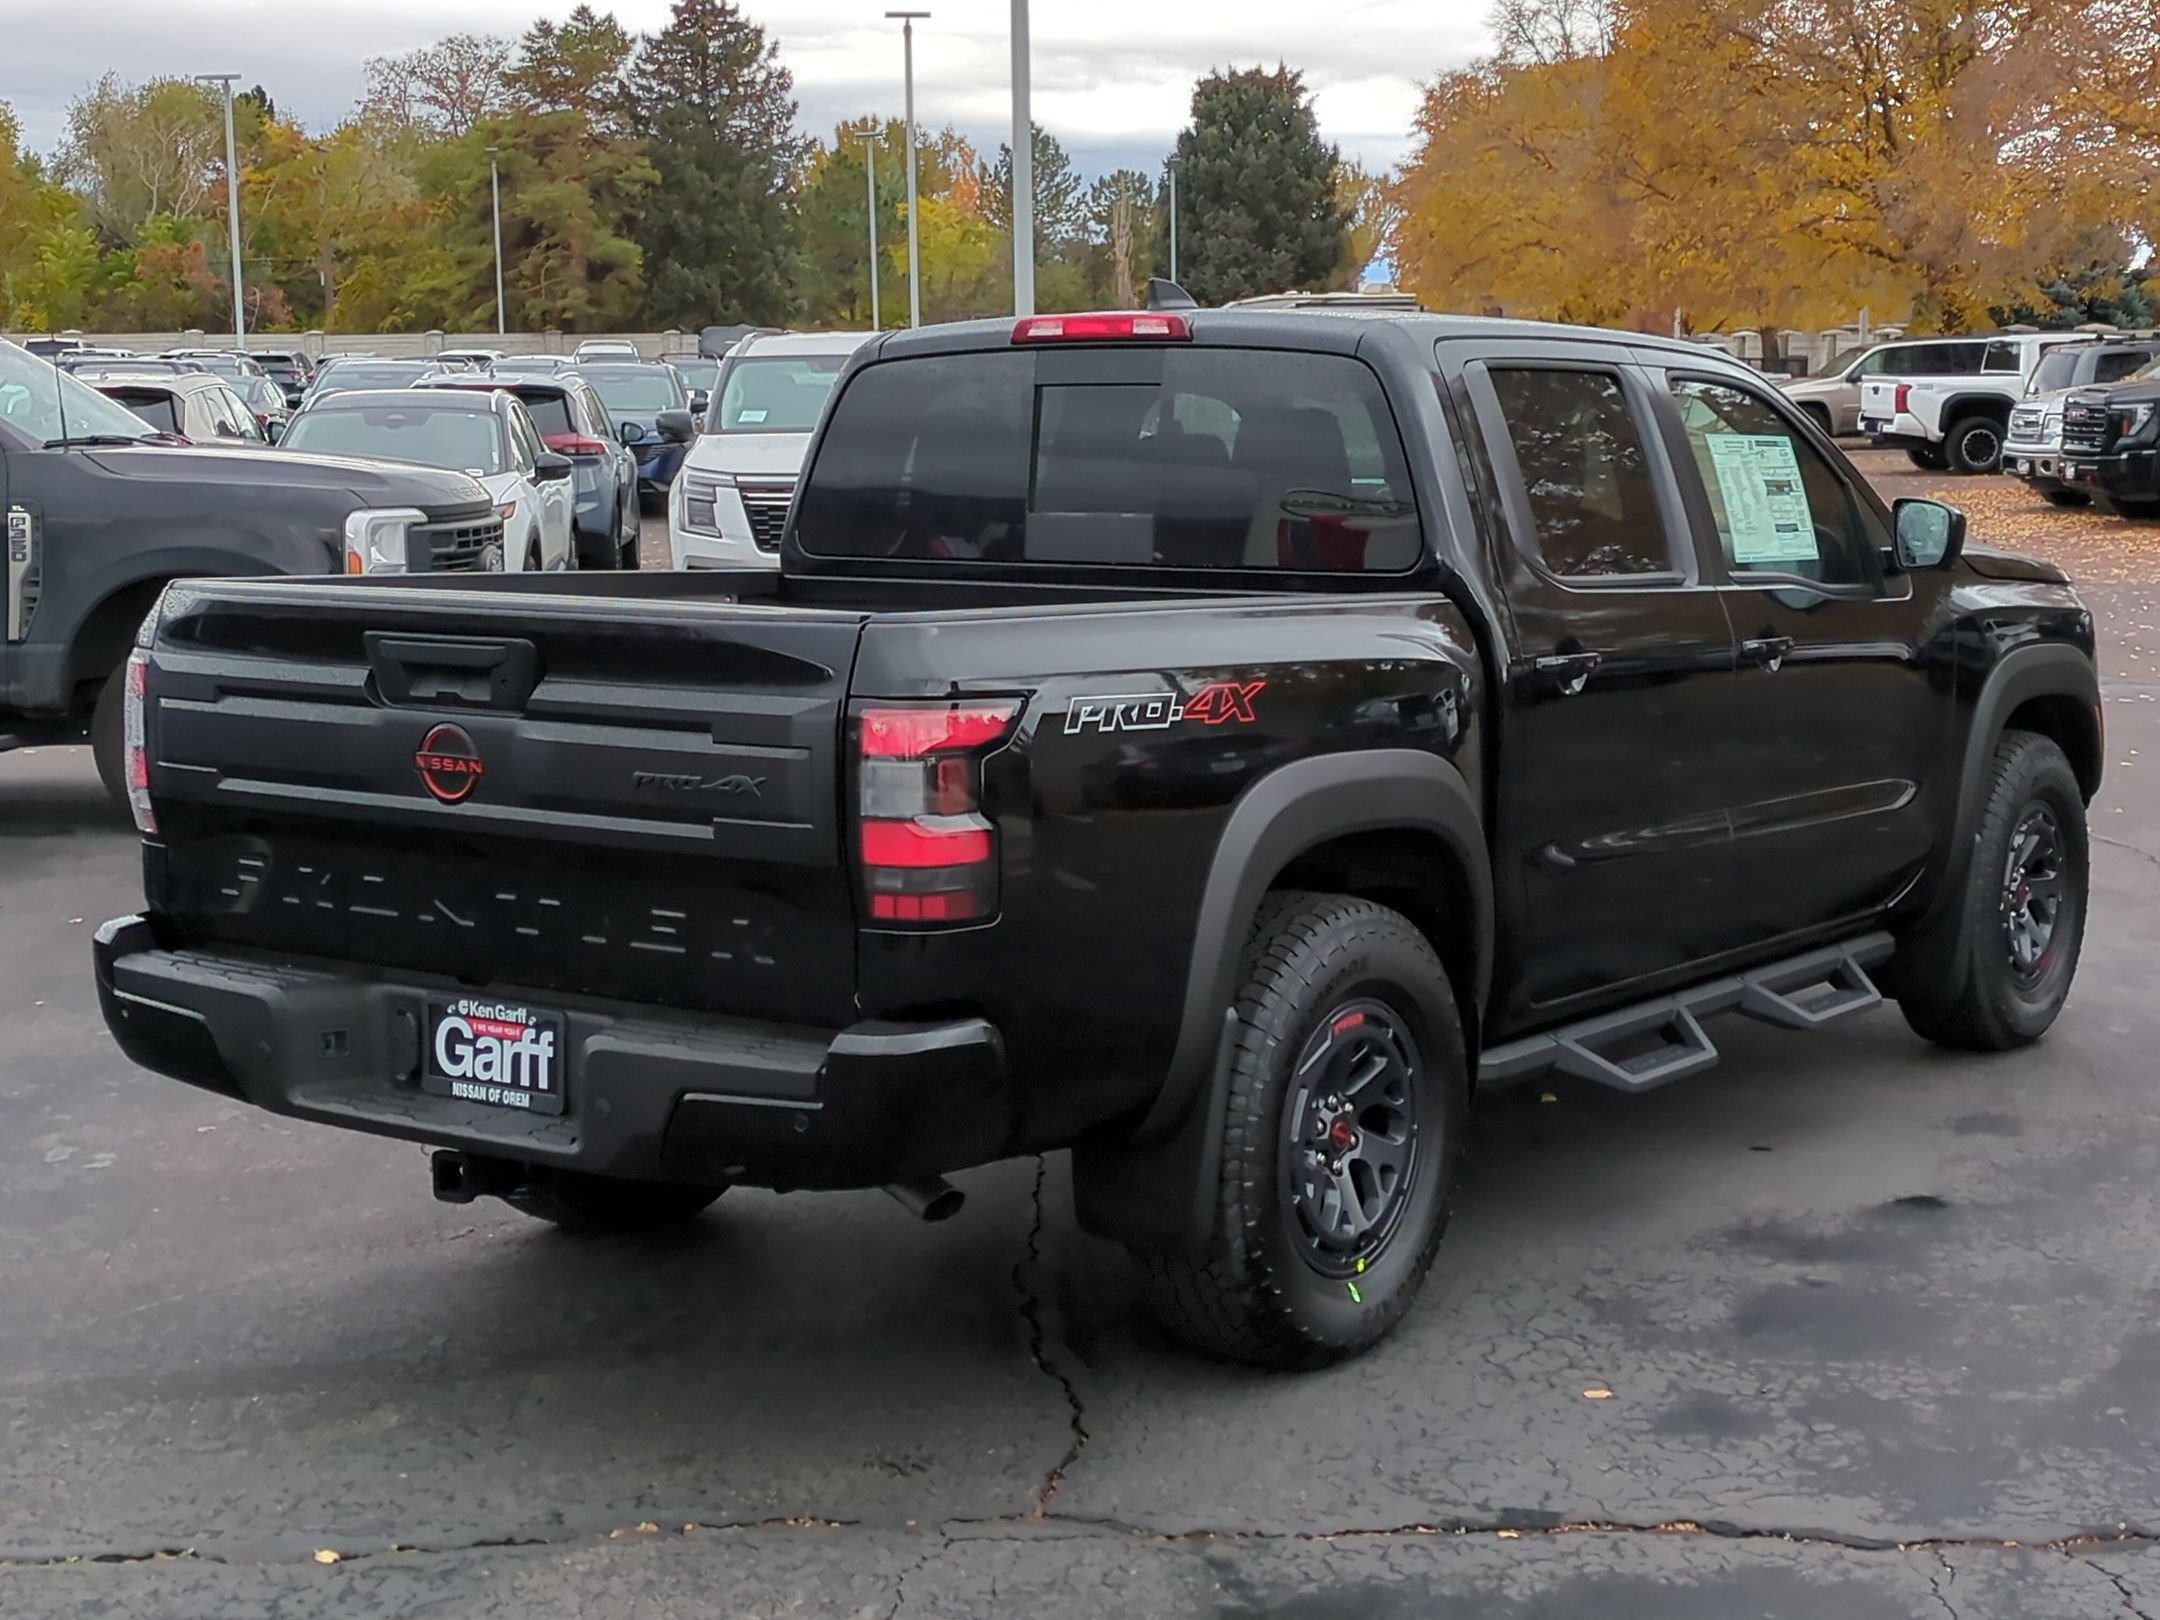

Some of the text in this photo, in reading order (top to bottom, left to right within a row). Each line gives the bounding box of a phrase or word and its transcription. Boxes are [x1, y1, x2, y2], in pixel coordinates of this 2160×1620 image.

[415, 755, 484, 774] NISSAN
[469, 1001, 527, 1024] Ken Garff
[435, 1016, 553, 1090] Garff
[452, 1082, 530, 1108] NISSAN OF OREM
